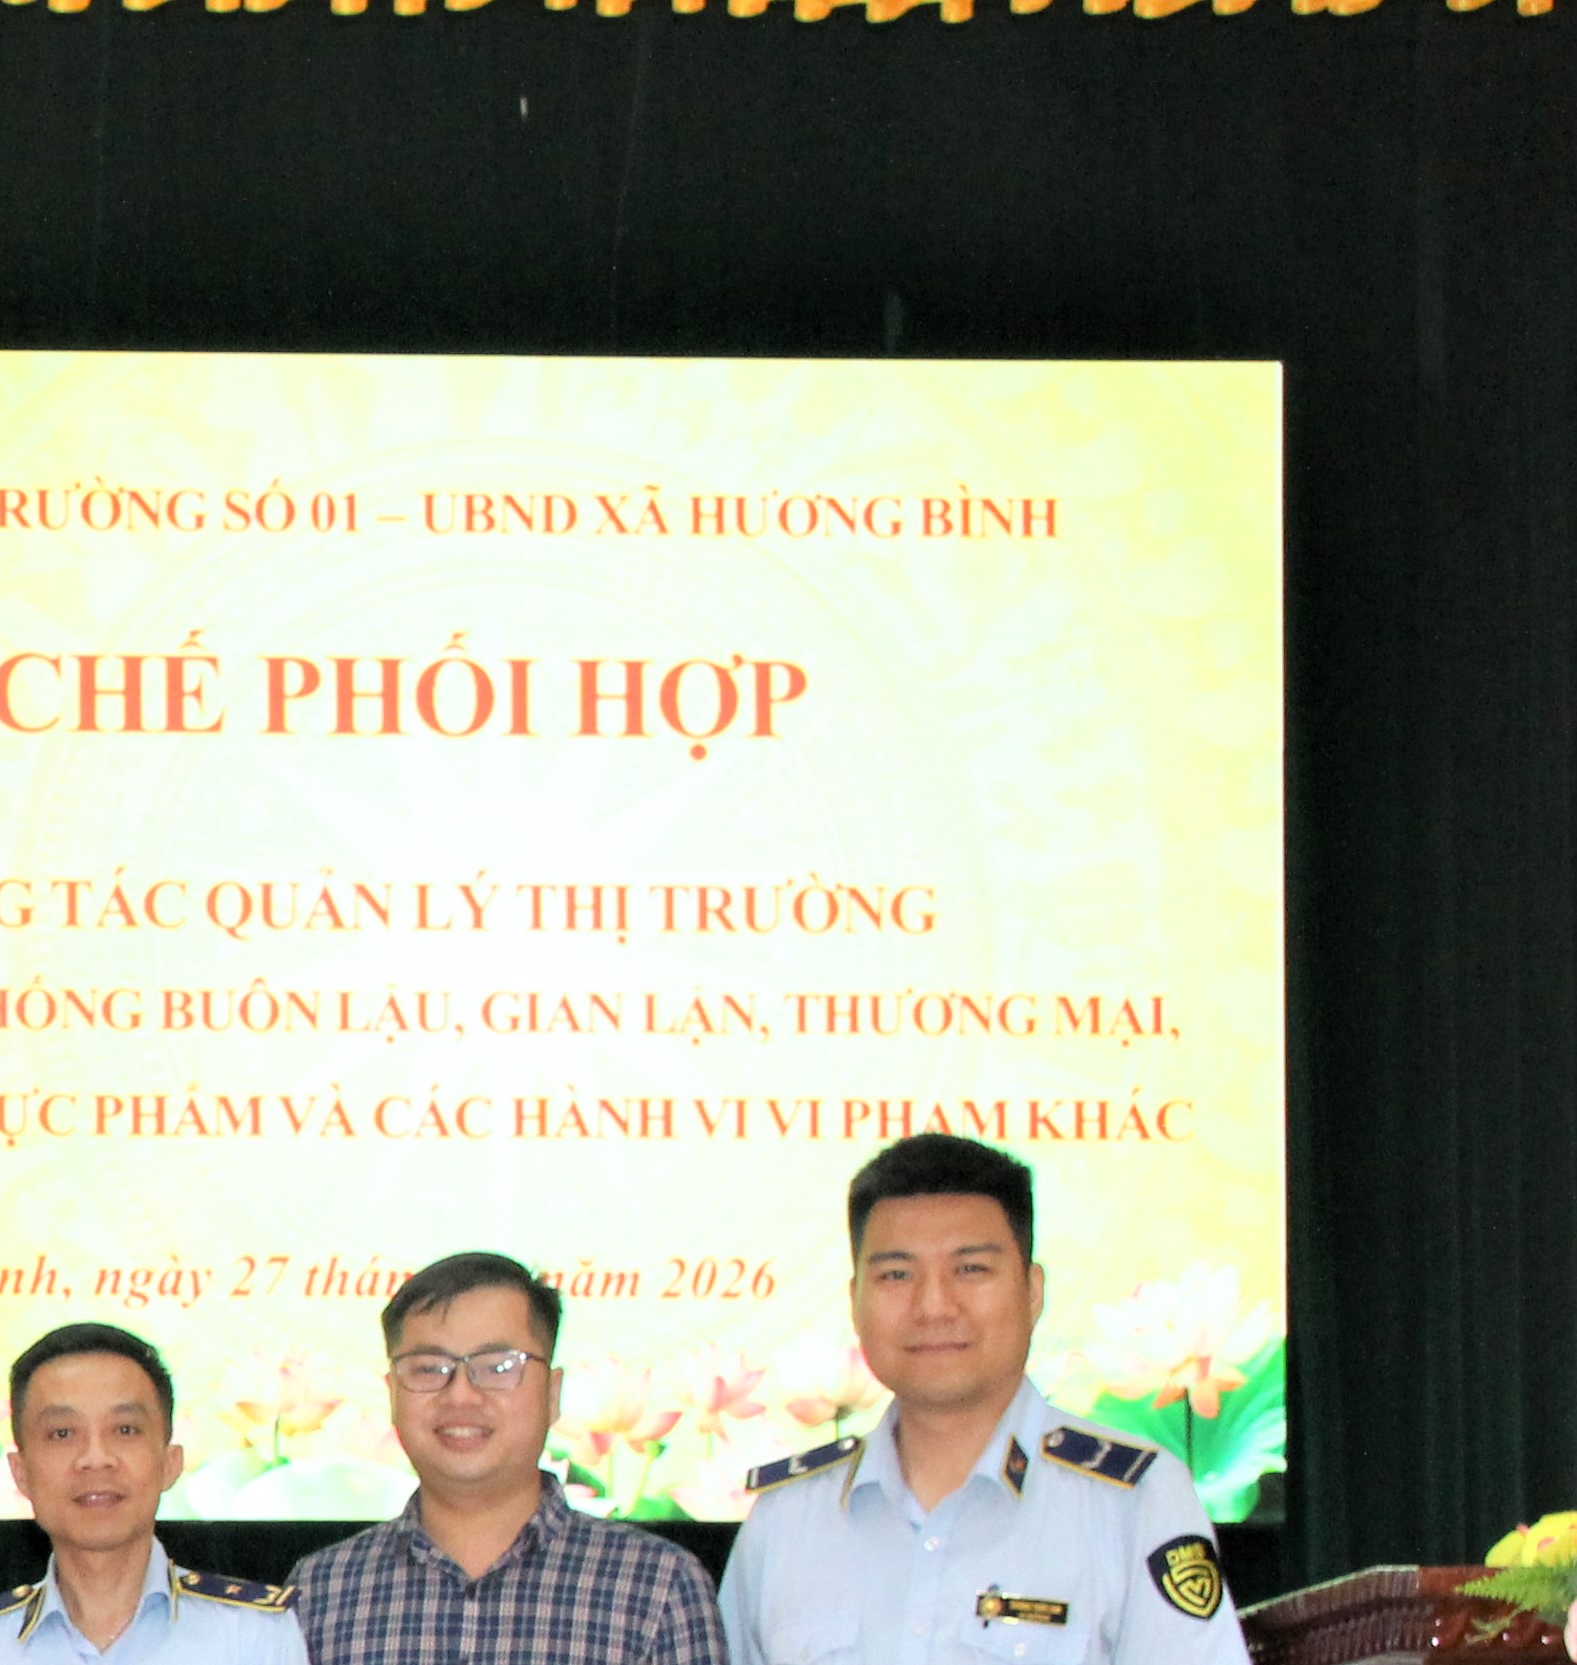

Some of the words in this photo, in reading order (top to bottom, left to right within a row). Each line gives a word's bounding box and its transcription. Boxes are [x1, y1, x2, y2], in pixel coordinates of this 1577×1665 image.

[224, 479, 296, 531] SỐ
[310, 493, 356, 532] 01
[423, 493, 578, 534] UBND
[595, 485, 669, 535] XÃ
[690, 491, 902, 538] HƯƠNG
[921, 484, 1057, 538] BÌNH
[261, 632, 532, 737] PHỐI
[575, 653, 808, 761] HỢP
[51, 867, 186, 928] TÁC
[205, 869, 390, 940] QUẢN
[416, 870, 497, 930] LÝ
[516, 885, 628, 944] THỊ
[649, 872, 935, 933] TRƯỜNG
[163, 977, 318, 1031] BUÔN
[481, 993, 620, 1033] GIAN
[786, 988, 1036, 1035] THƯƠNG
[1056, 995, 1180, 1048] MẠI,
[280, 1084, 355, 1137] VÀ
[374, 1084, 491, 1137] CÁC
[514, 1086, 674, 1139] HÀNH
[693, 1099, 747, 1139] VI
[766, 1099, 820, 1139] VI
[1027, 1088, 1192, 1141] KHÁC
[94, 1255, 212, 1309] ngày
[230, 1255, 290, 1296] 27
[661, 1258, 775, 1299] 2026
